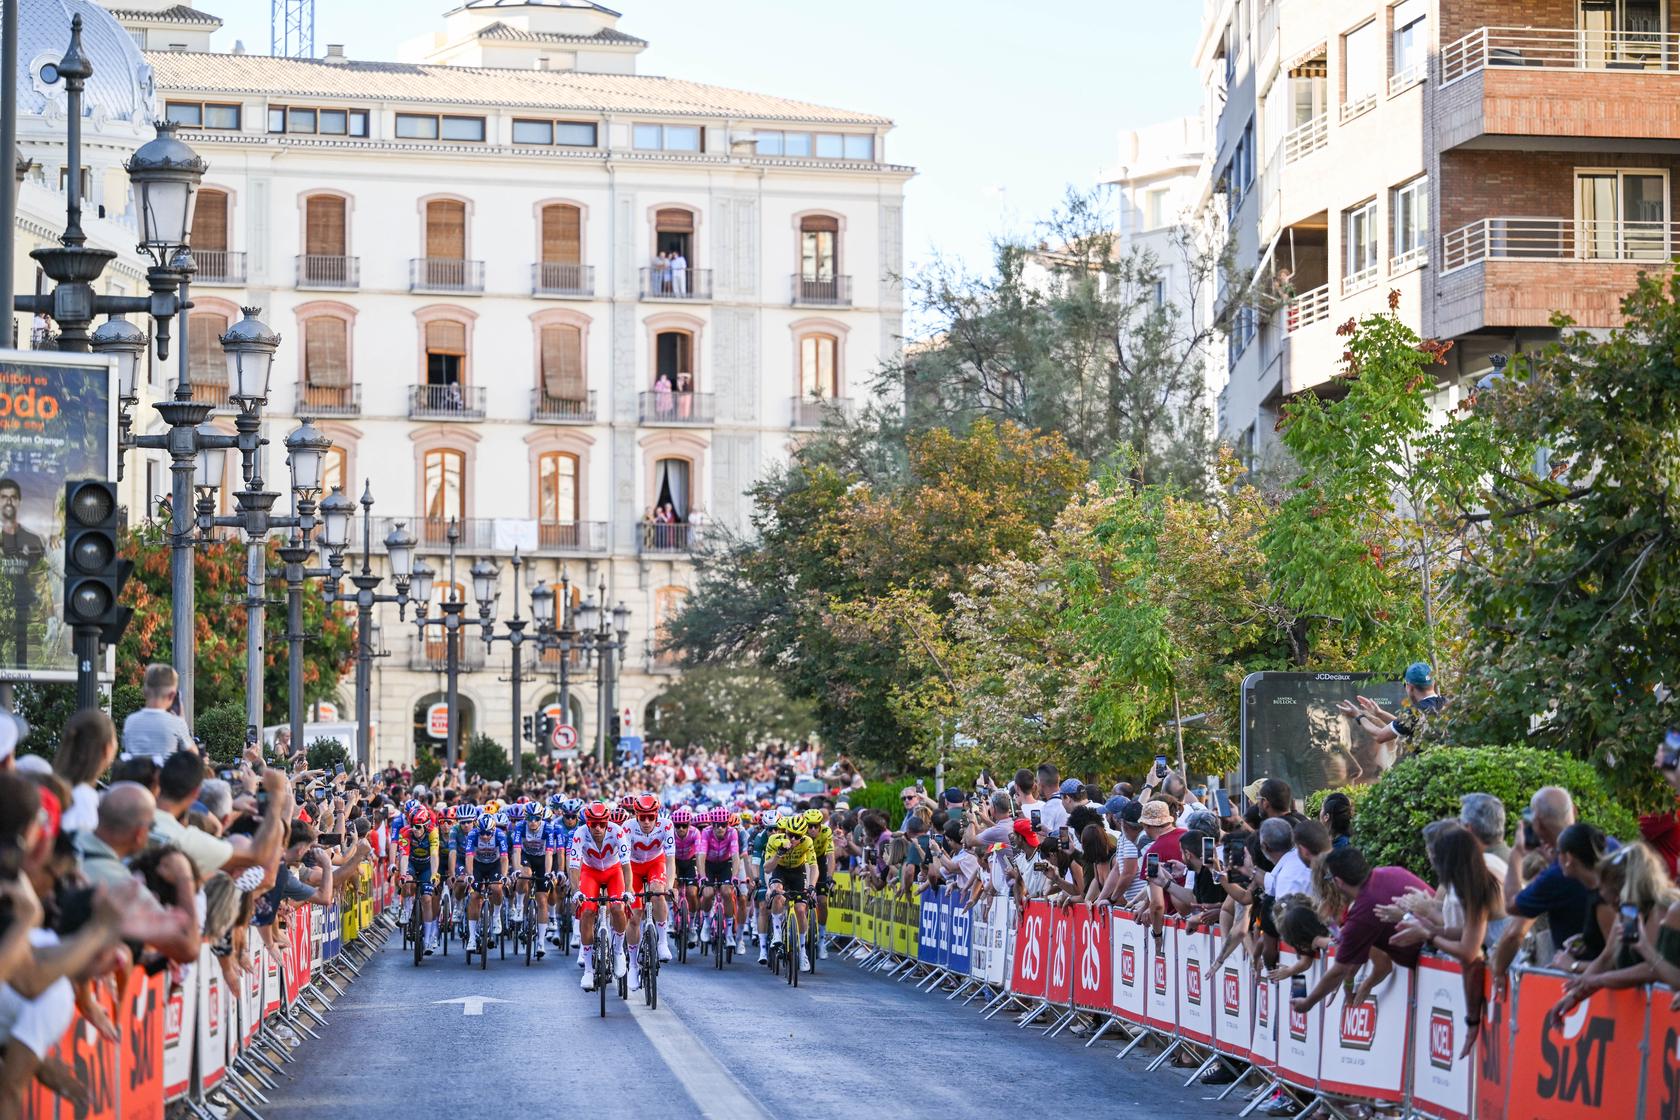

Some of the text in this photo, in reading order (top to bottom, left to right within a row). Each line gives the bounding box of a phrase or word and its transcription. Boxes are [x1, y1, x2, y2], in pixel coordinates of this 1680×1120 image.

[0, 387, 58, 419] odo
[1, 670, 32, 680] Decaux
[1315, 673, 1350, 681] JCDecaux
[1022, 915, 1042, 981] as
[1053, 919, 1067, 987] as
[1081, 919, 1100, 992] as
[1343, 1006, 1370, 1037] NOEL
[1432, 1023, 1450, 1057] NOEL
